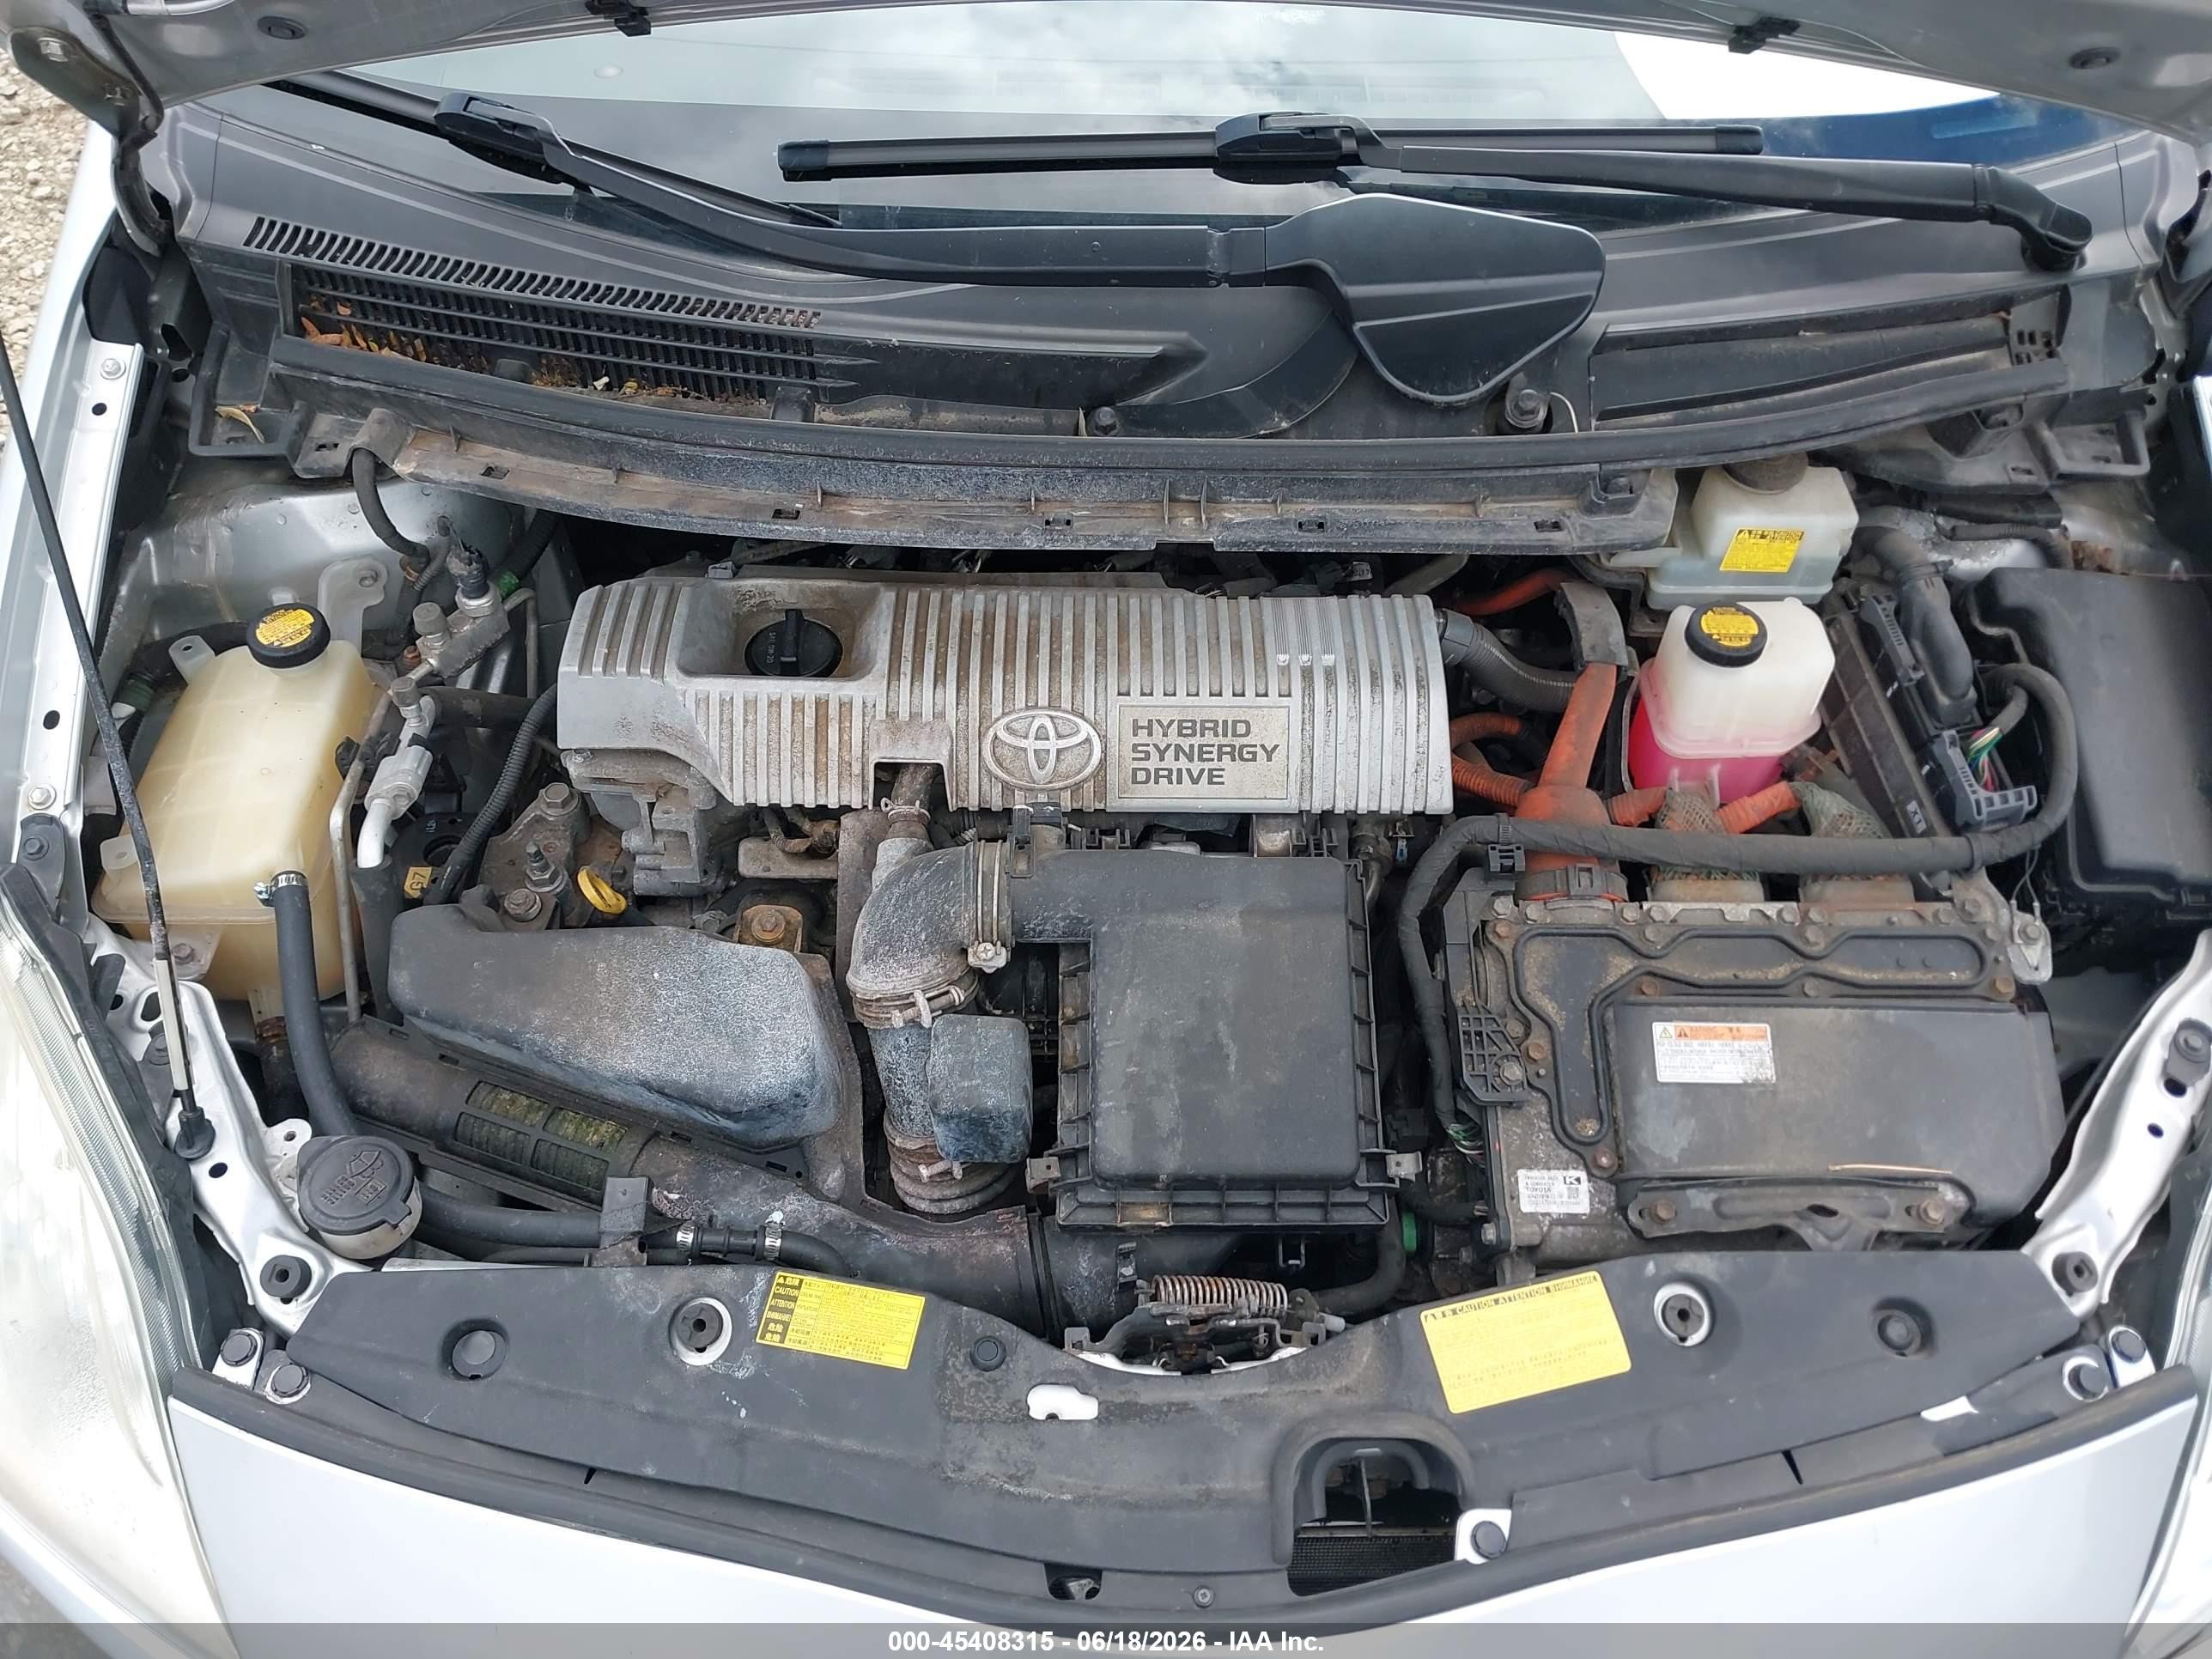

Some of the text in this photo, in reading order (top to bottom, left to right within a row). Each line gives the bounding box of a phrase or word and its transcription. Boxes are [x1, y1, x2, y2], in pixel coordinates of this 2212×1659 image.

[1132, 718, 1251, 738] HYBRID
[1131, 743, 1279, 763] SYNERGY
[1131, 767, 1225, 785] DRIVE
[775, 1286, 799, 1297] CAUTION
[1457, 1300, 1495, 1315] CAUTION
[1500, 1286, 1547, 1304] ATTENTION
[770, 1299, 795, 1310] ATTENTION
